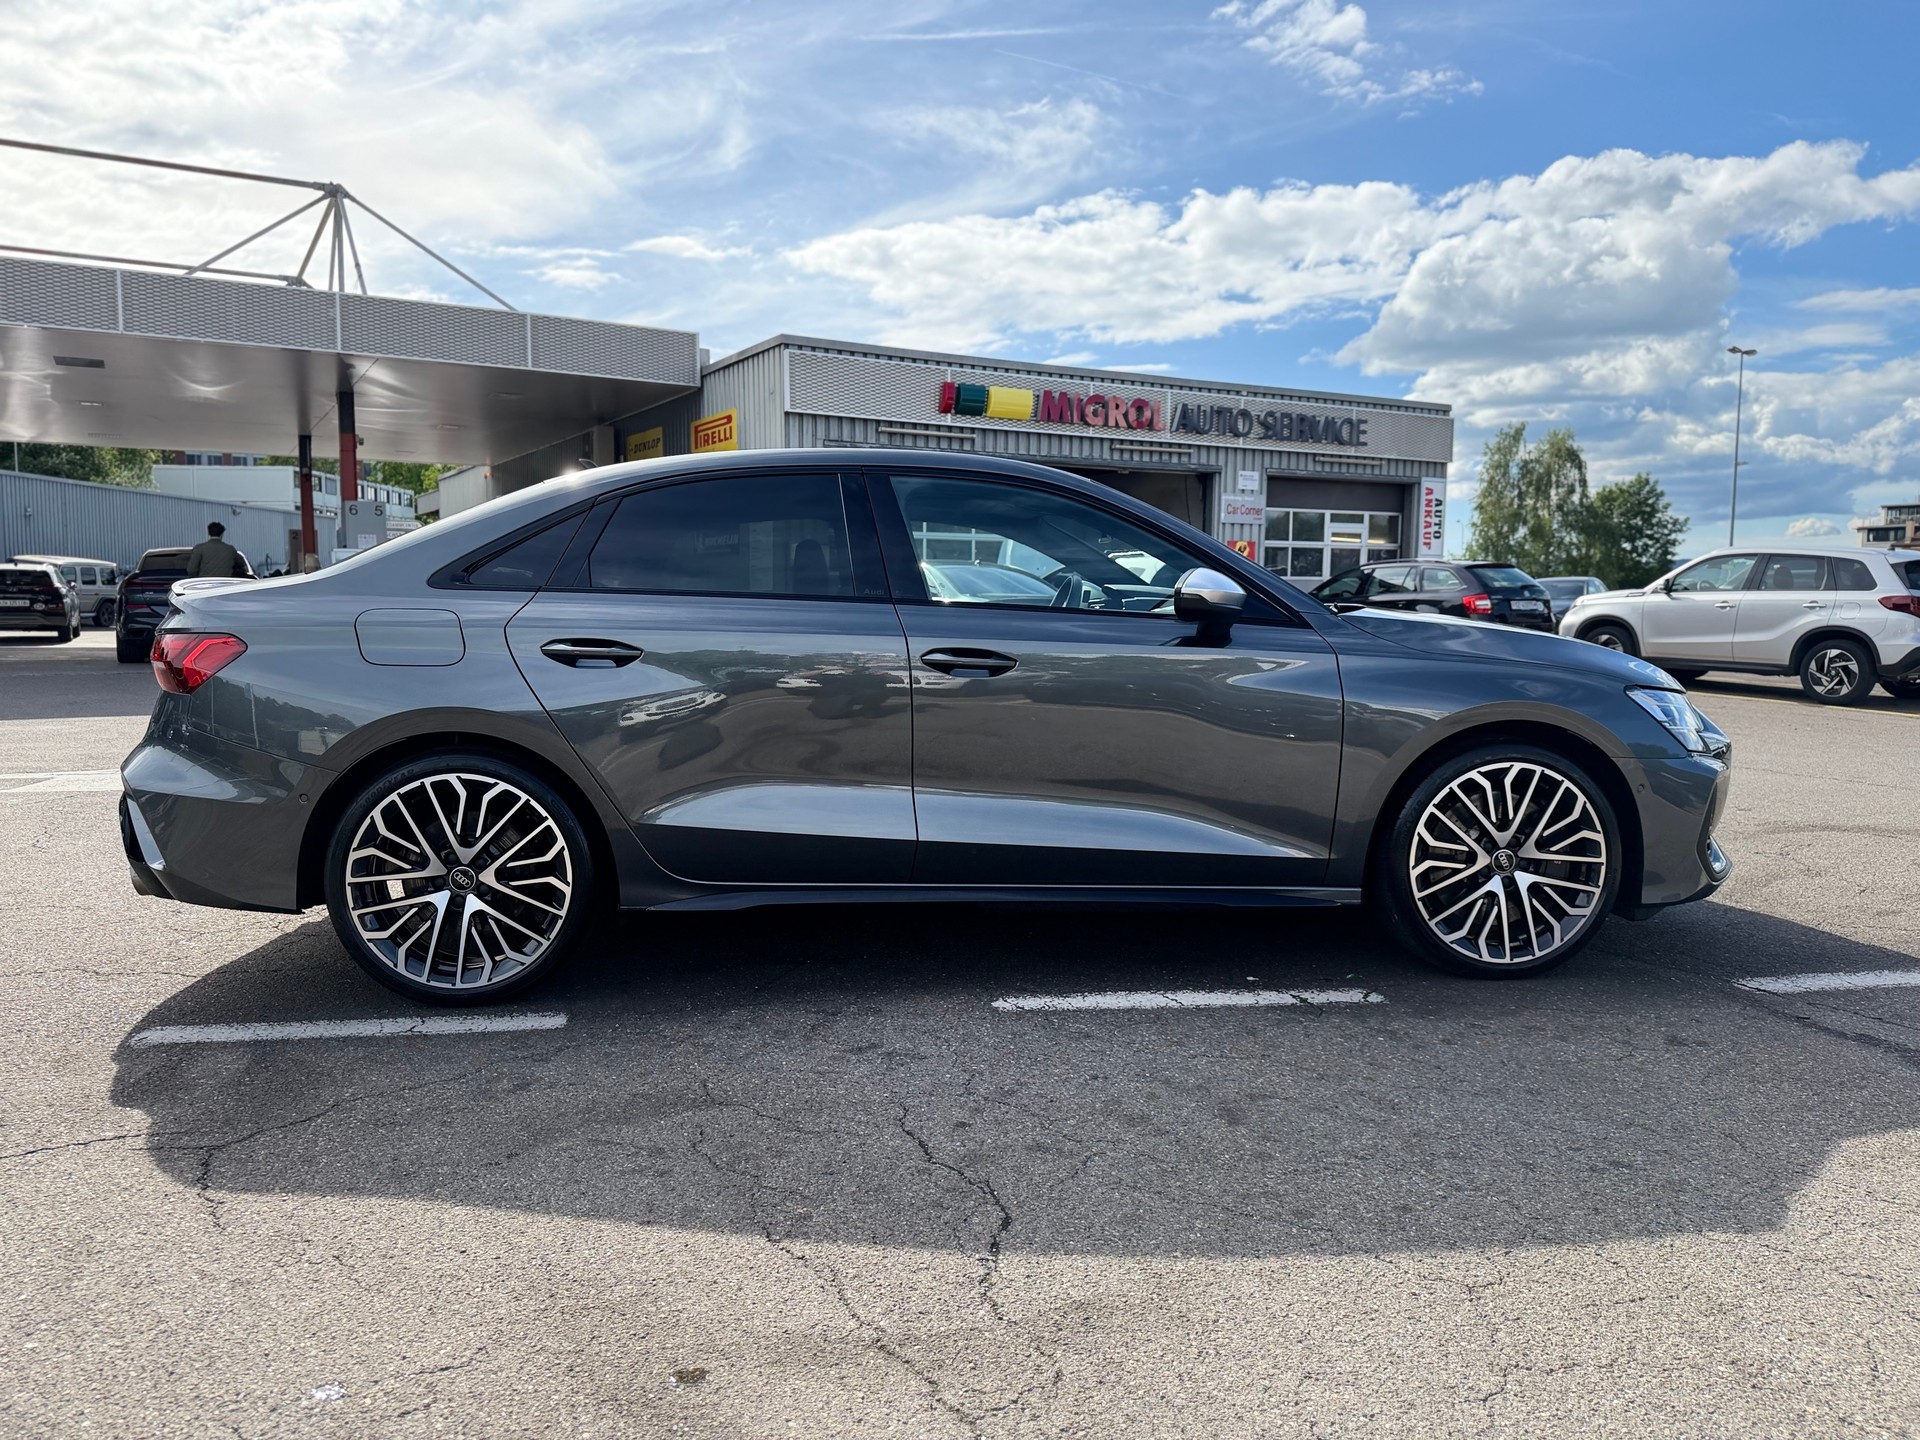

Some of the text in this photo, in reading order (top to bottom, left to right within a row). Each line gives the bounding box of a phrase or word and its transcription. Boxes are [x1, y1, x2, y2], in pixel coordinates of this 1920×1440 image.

[1039, 389, 1369, 447] MIGROL AUTO SERVICE
[633, 436, 661, 454] DUNLOP
[694, 414, 733, 450] PIRELLI
[349, 504, 359, 516] 6
[374, 505, 384, 517] 5
[1226, 503, 1263, 516] Car Corner
[1423, 487, 1434, 550] ANKAUF
[1433, 498, 1443, 539] AUTO
